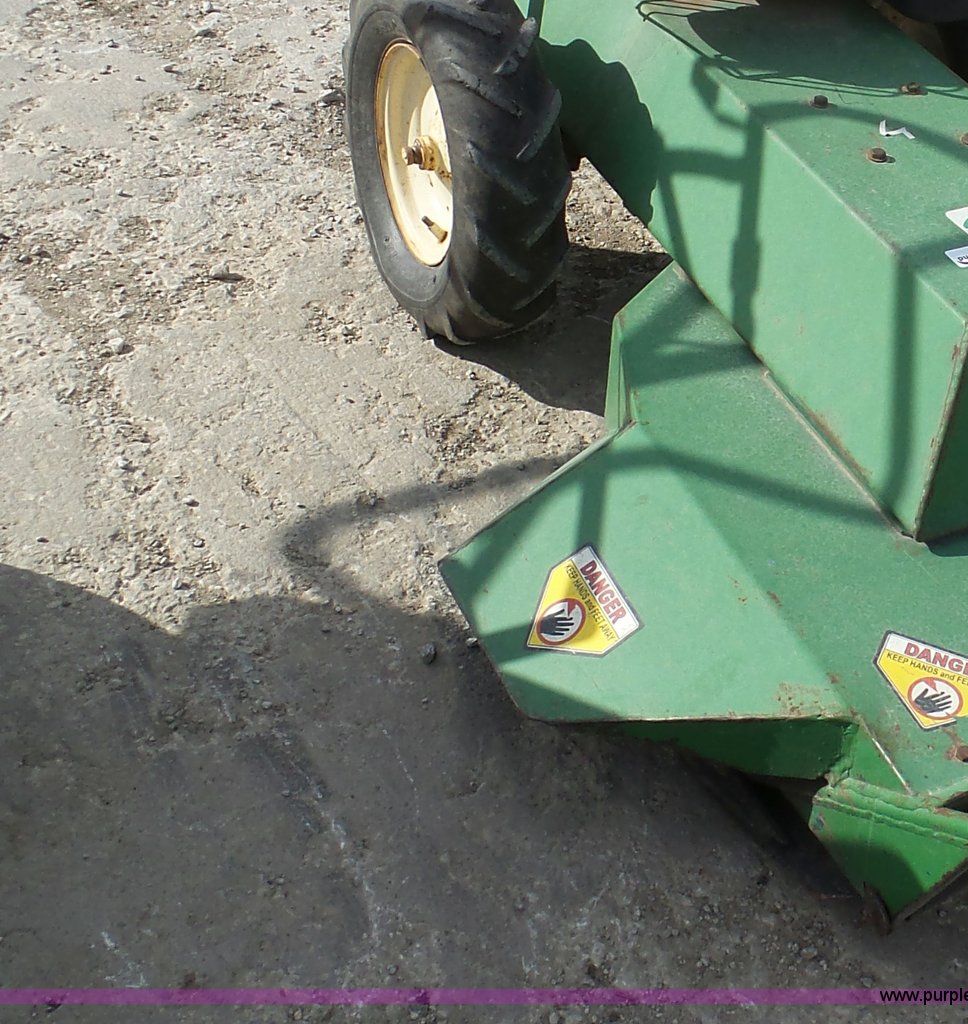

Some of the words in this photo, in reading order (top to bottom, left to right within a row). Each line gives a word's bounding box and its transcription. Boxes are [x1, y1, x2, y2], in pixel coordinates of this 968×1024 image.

[565, 564, 577, 580] KEEP
[573, 578, 591, 601] HANDS
[584, 598, 595, 611] and
[591, 606, 605, 625] FEET
[599, 622, 616, 641] AWAY
[580, 560, 627, 625] DANGER
[886, 652, 909, 664] KEEP
[910, 660, 939, 675] HANDS
[940, 671, 955, 681] and
